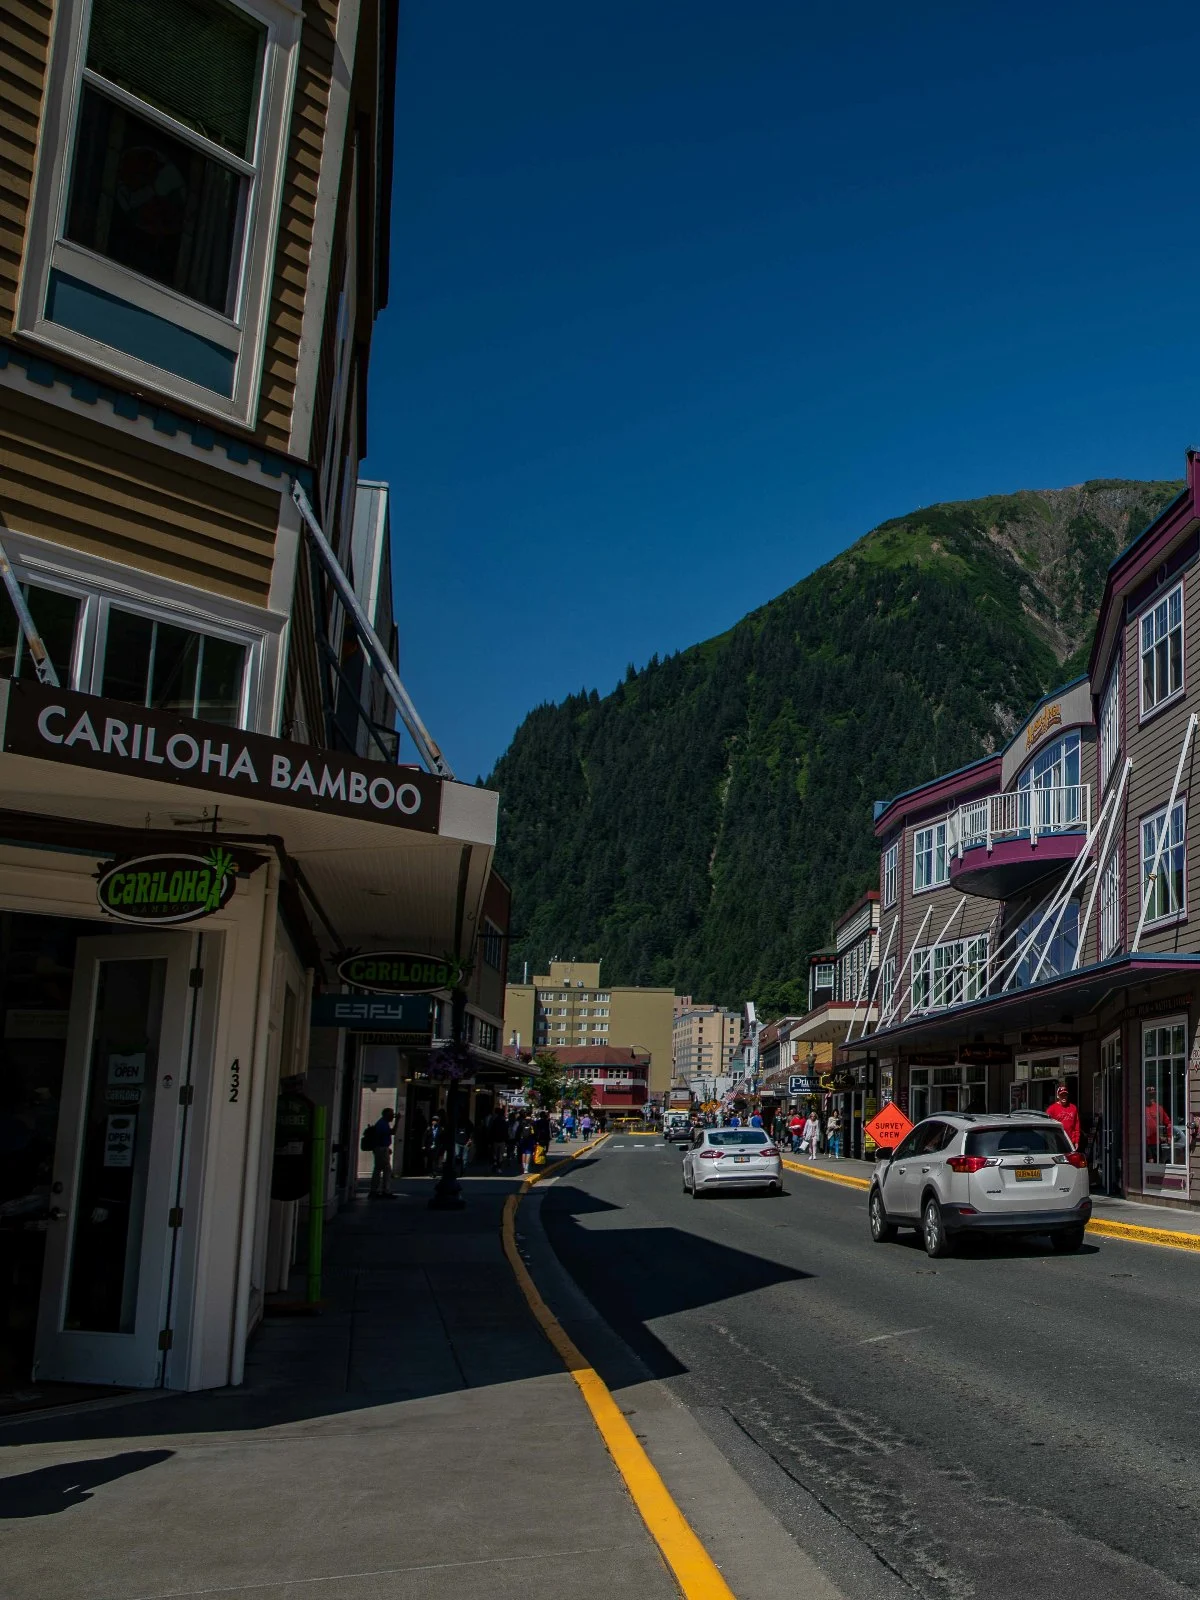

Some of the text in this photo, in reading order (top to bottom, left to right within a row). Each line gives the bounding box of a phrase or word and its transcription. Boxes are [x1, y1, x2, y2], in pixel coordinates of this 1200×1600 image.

[37, 705, 422, 815] CARILOHA BAMBOO
[334, 1003, 404, 1020] EFFY
[114, 1066, 140, 1078] OPEN
[875, 1122, 905, 1130] SURVEY
[108, 1132, 131, 1142] OPEN
